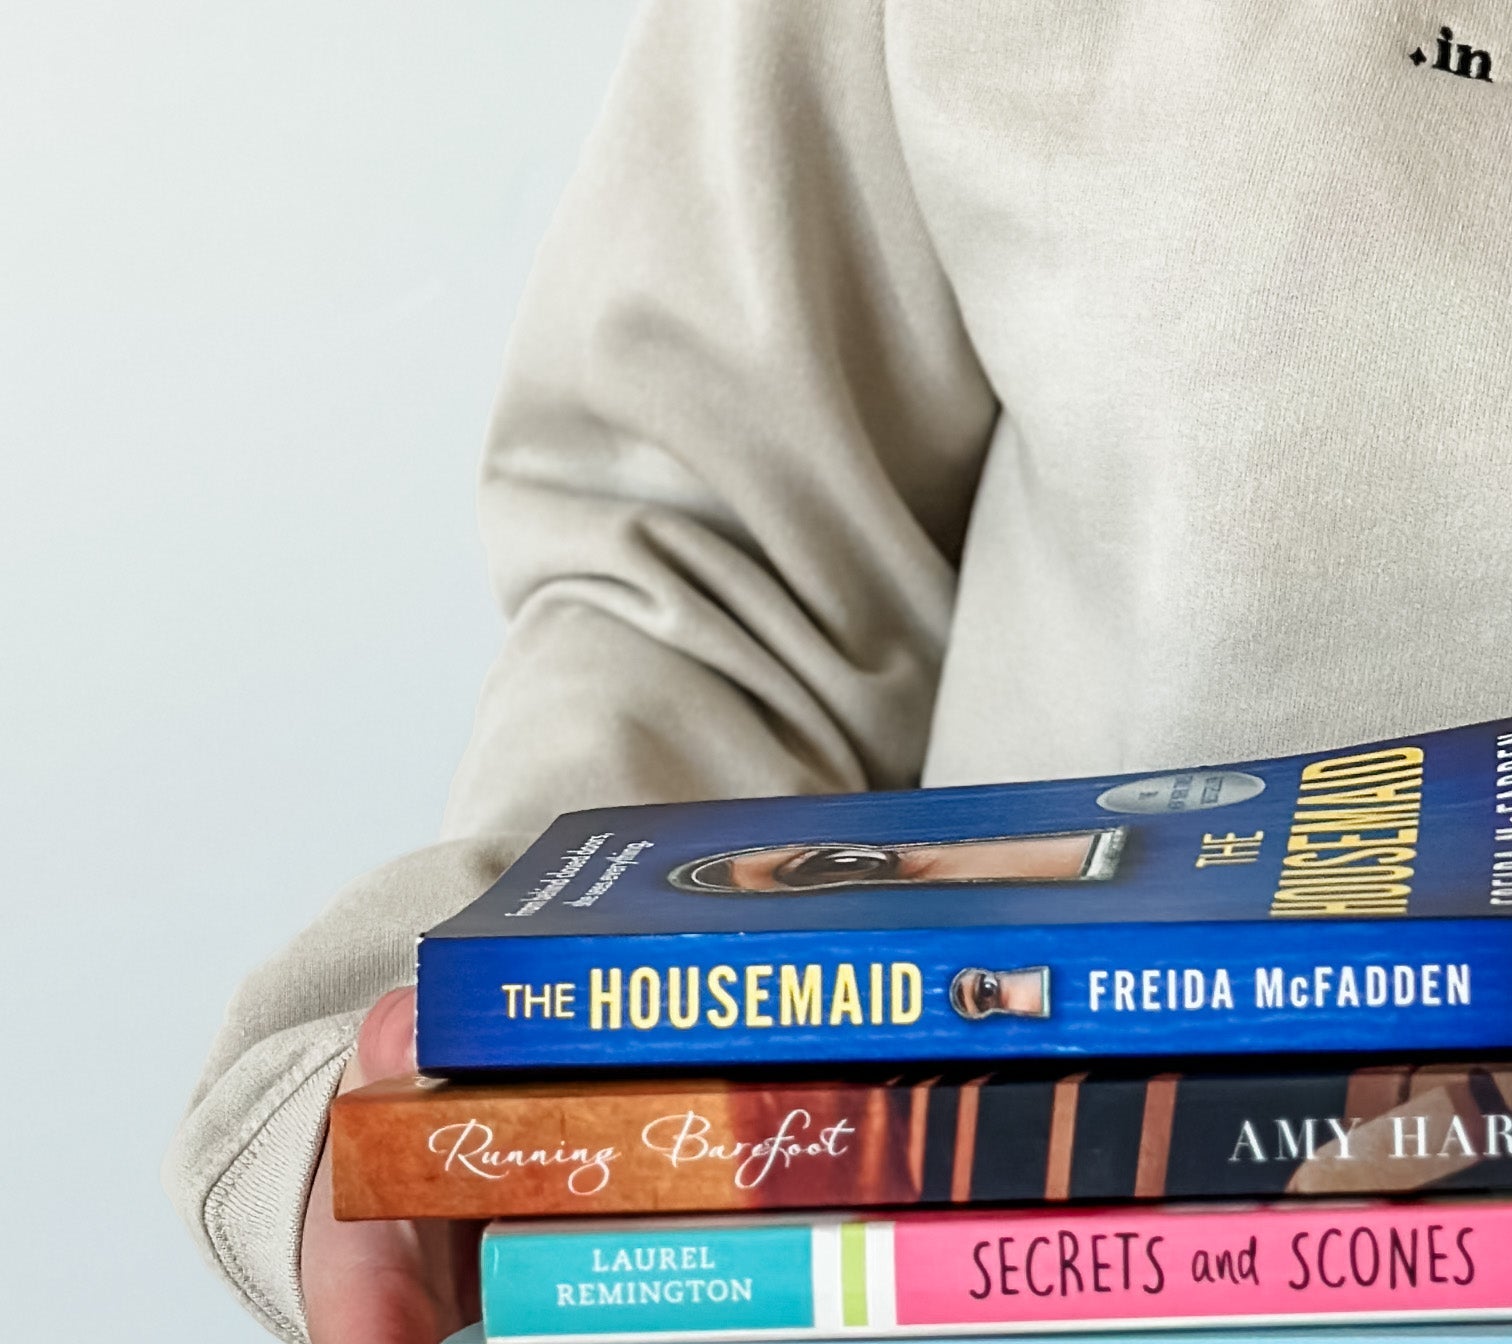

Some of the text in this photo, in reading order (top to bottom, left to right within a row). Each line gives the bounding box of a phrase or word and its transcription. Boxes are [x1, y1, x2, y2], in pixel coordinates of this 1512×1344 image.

[1433, 26, 1493, 83] in
[1196, 831, 1264, 868] THE
[1269, 746, 1424, 917] HOUSEMAID
[502, 962, 923, 1031] THE HOUSEMAID
[1089, 964, 1471, 1013] FREIDA McFADDEN
[428, 1109, 855, 1196] Running Barefoot
[1229, 1117, 1360, 1162] AMY
[592, 1246, 715, 1273] LAUREL
[969, 1225, 1475, 1300] SECRETS and SCONES
[556, 1277, 753, 1309] REMINGTON
